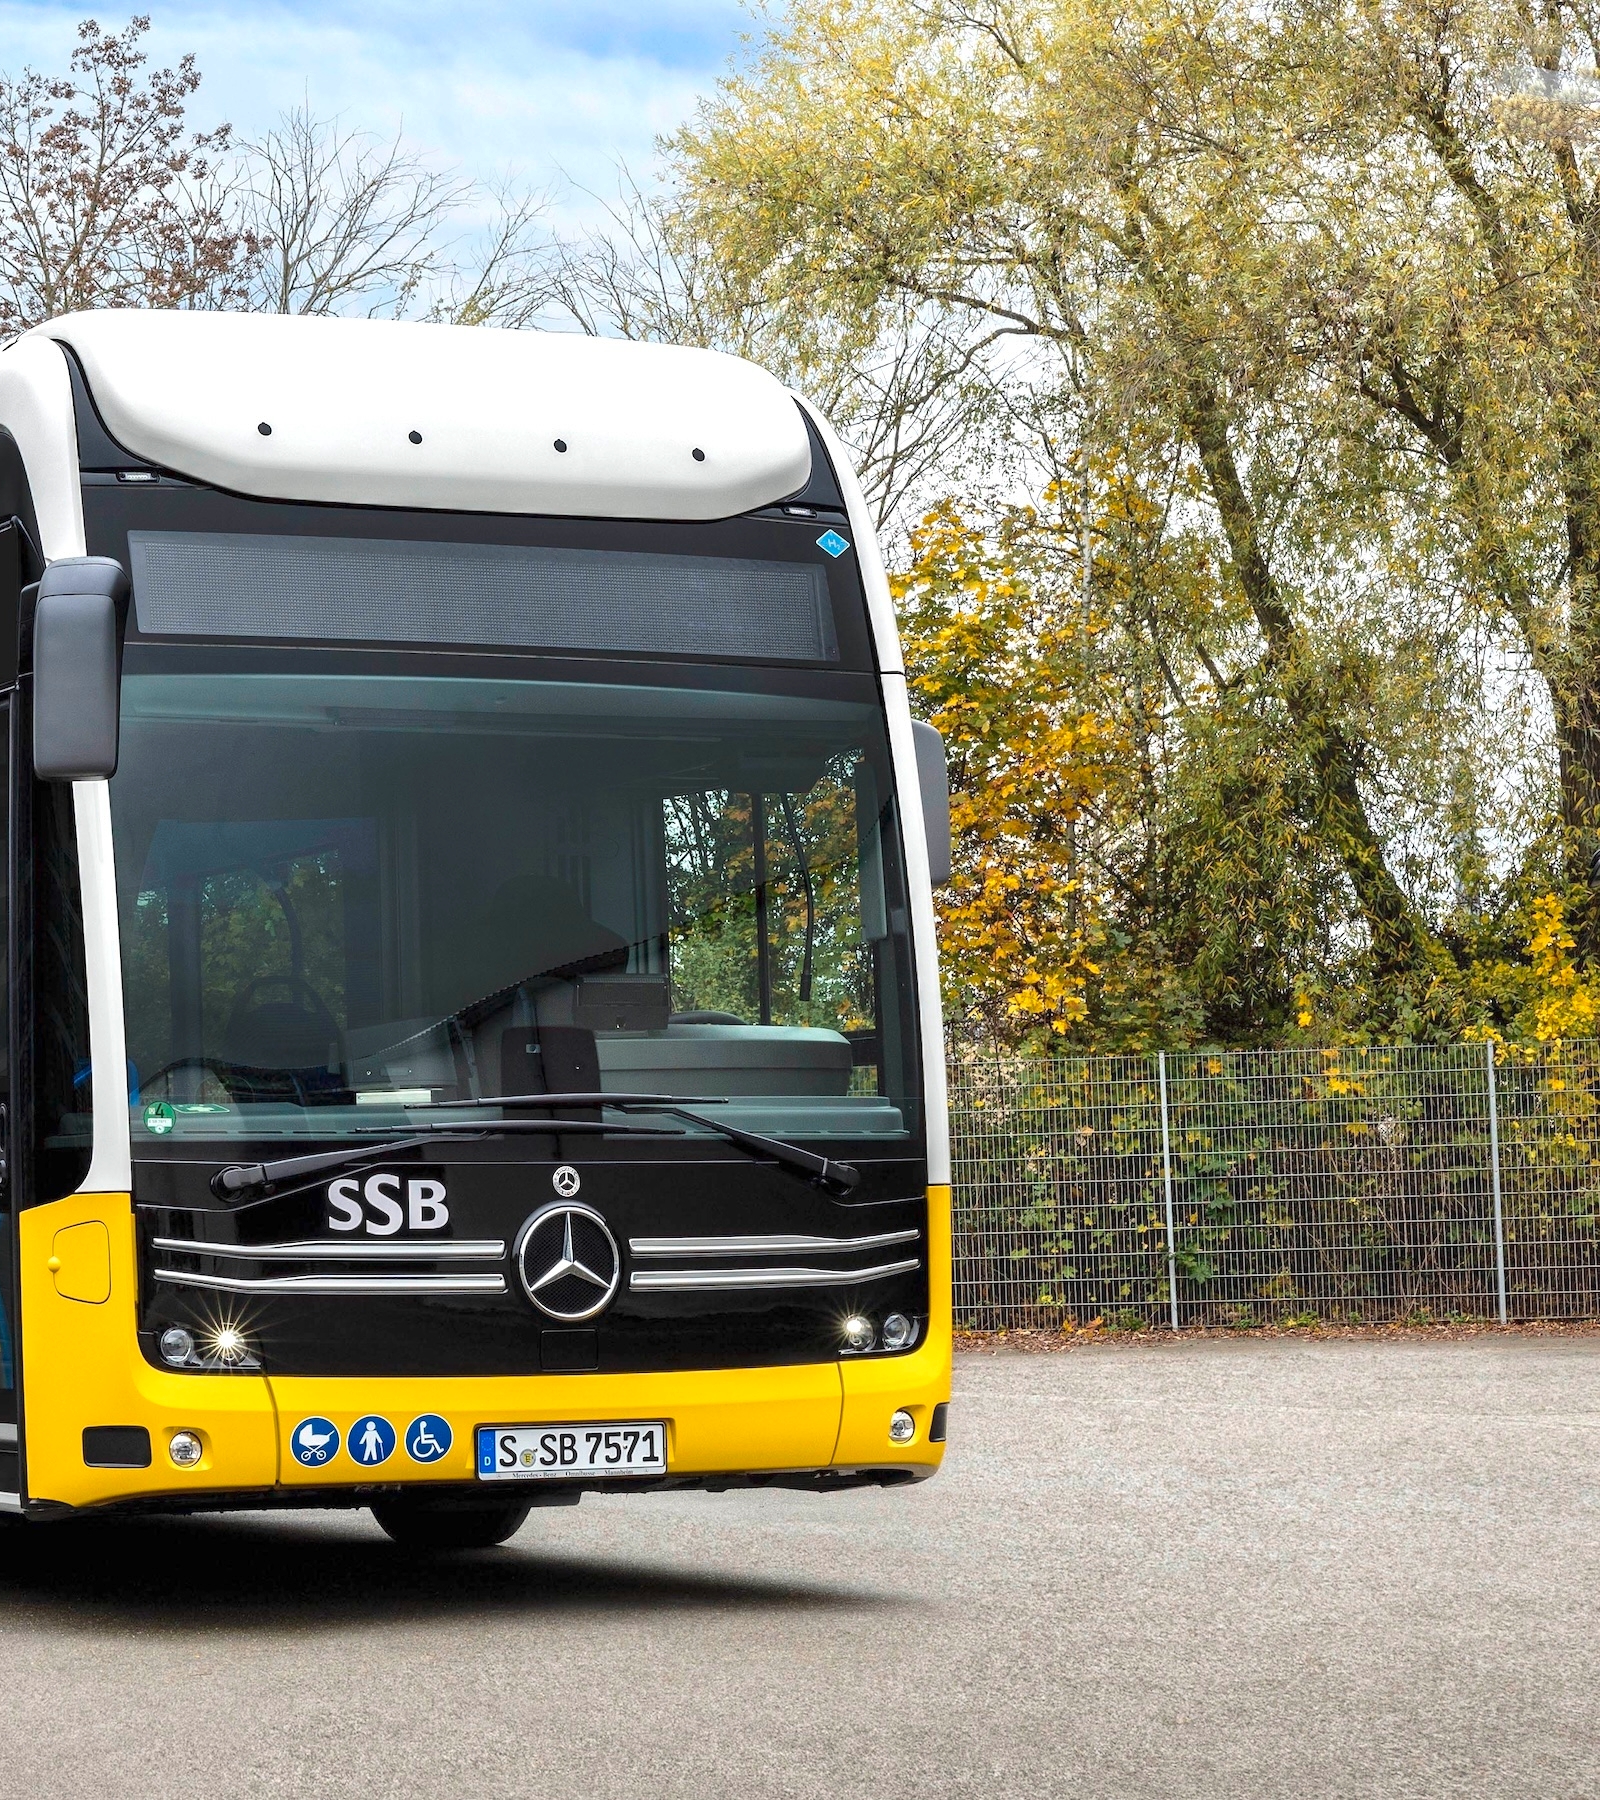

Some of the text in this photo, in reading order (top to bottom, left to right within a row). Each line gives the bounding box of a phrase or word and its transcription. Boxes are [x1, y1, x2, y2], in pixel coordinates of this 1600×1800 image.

[155, 1102, 165, 1118] 4
[327, 1173, 450, 1236] SSB
[484, 1456, 492, 1467] D
[499, 1430, 659, 1468] S SB 7571
